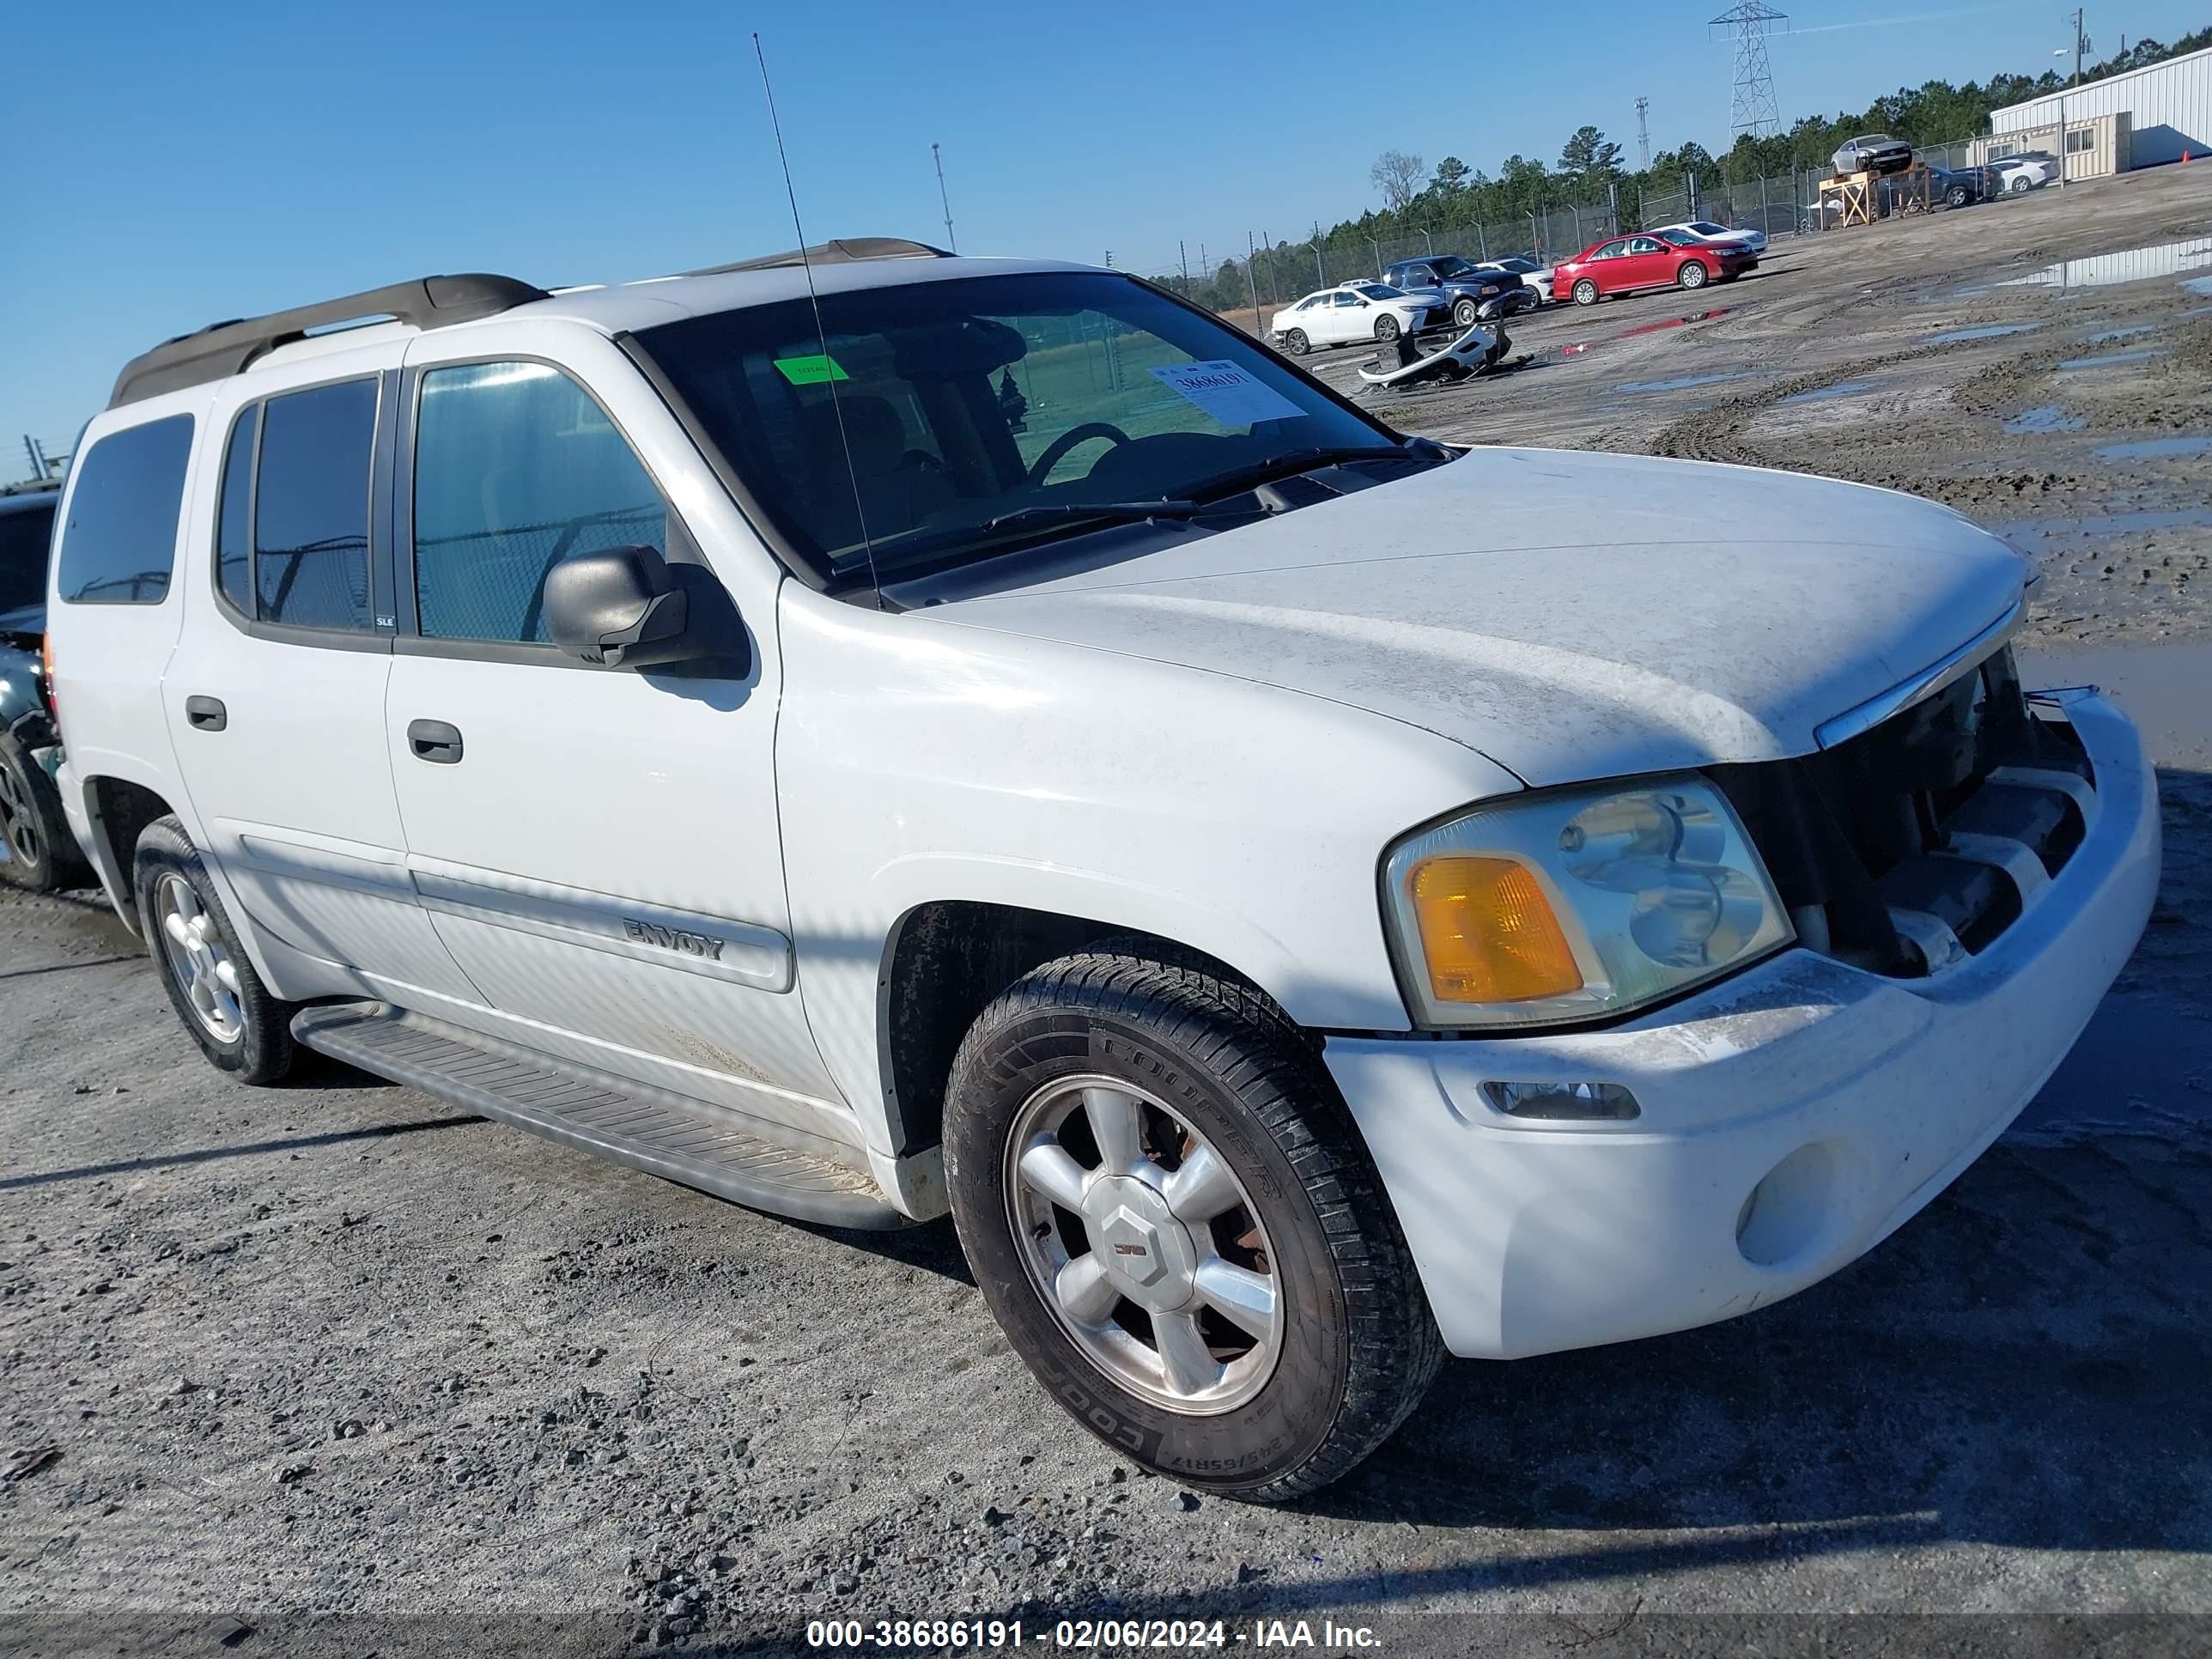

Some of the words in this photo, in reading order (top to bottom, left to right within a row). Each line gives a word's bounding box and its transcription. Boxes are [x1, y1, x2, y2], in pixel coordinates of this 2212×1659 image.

[1175, 372, 1251, 392] 38686191
[376, 617, 394, 627] SLE
[623, 917, 726, 962] ENVOY
[1103, 1037, 1283, 1200] COOPER
